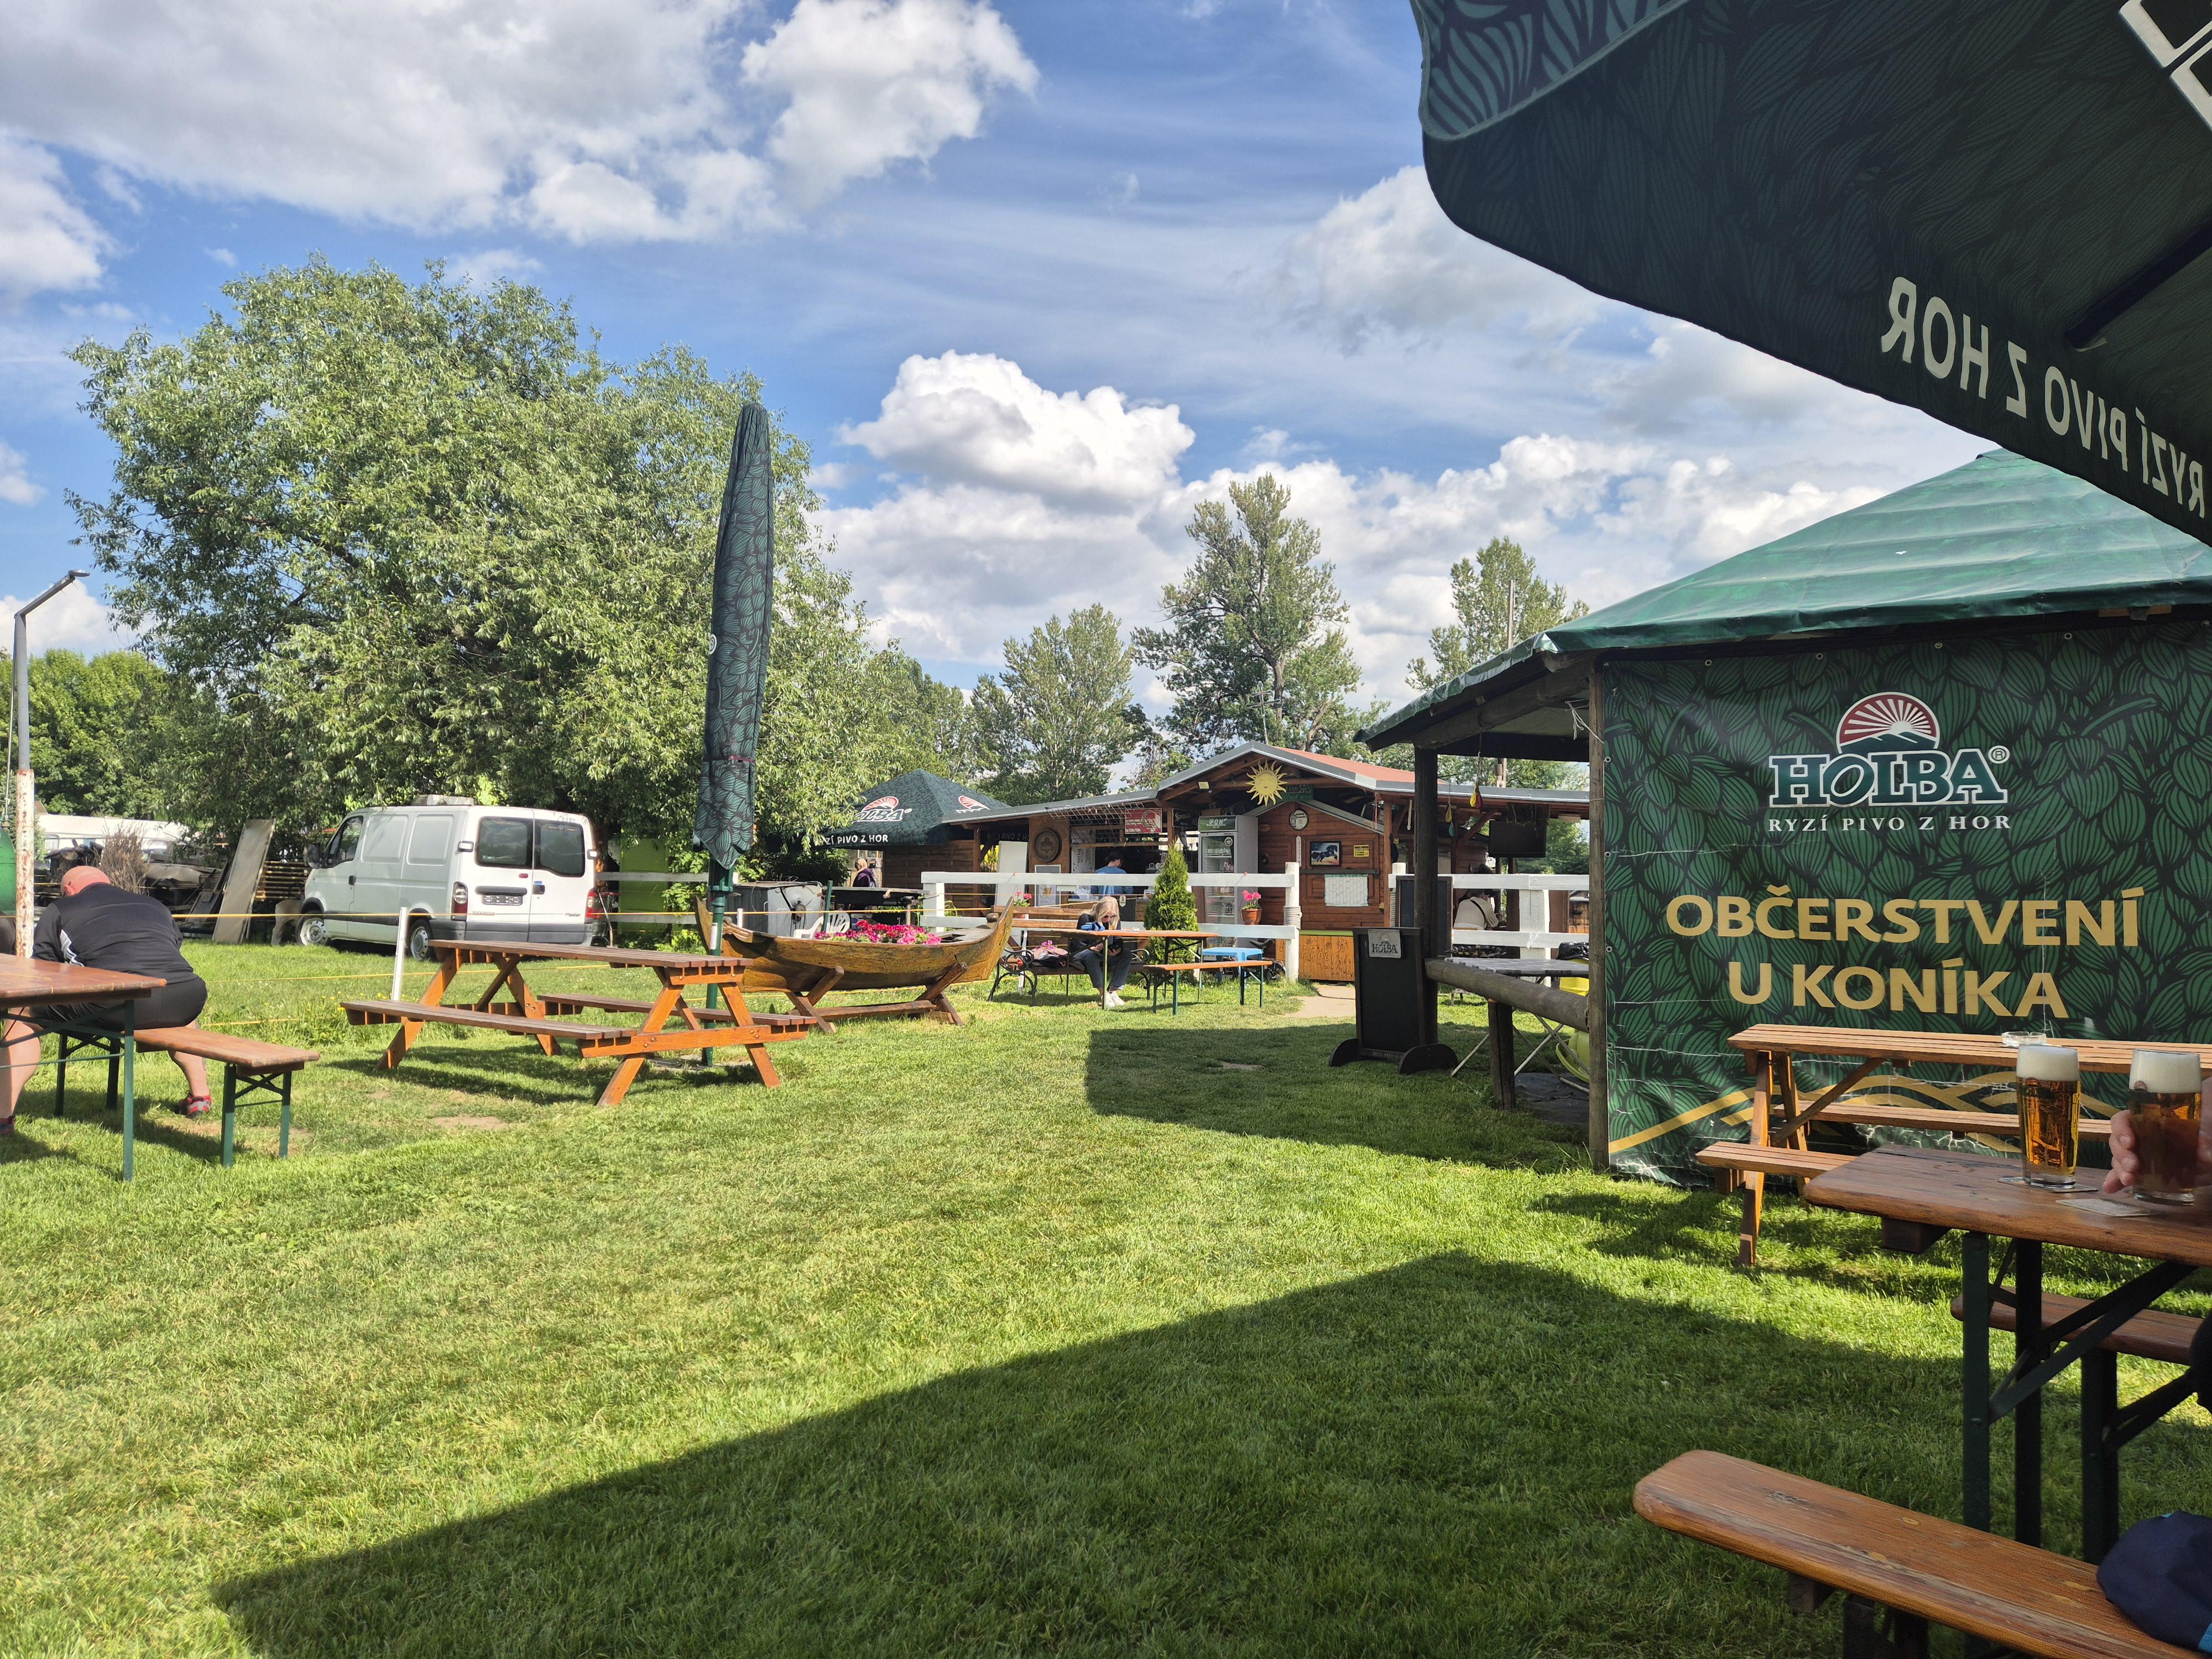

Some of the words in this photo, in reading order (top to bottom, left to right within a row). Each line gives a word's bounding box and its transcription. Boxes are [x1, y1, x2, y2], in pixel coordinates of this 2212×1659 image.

[1768, 749, 2008, 808] HOLBA
[837, 835, 858, 844] PIVO
[869, 834, 889, 843] HOR
[1768, 815, 1828, 832] RYZÍ
[1843, 817, 1905, 831] PIVO
[1919, 817, 1934, 830] Z
[1949, 815, 2011, 830] HOR
[1666, 884, 2145, 947] OBČERSTVENÍ
[1371, 943, 1398, 953] HOLBA
[1729, 962, 1772, 1005] U
[1793, 958, 2070, 1018] KONÍKA
